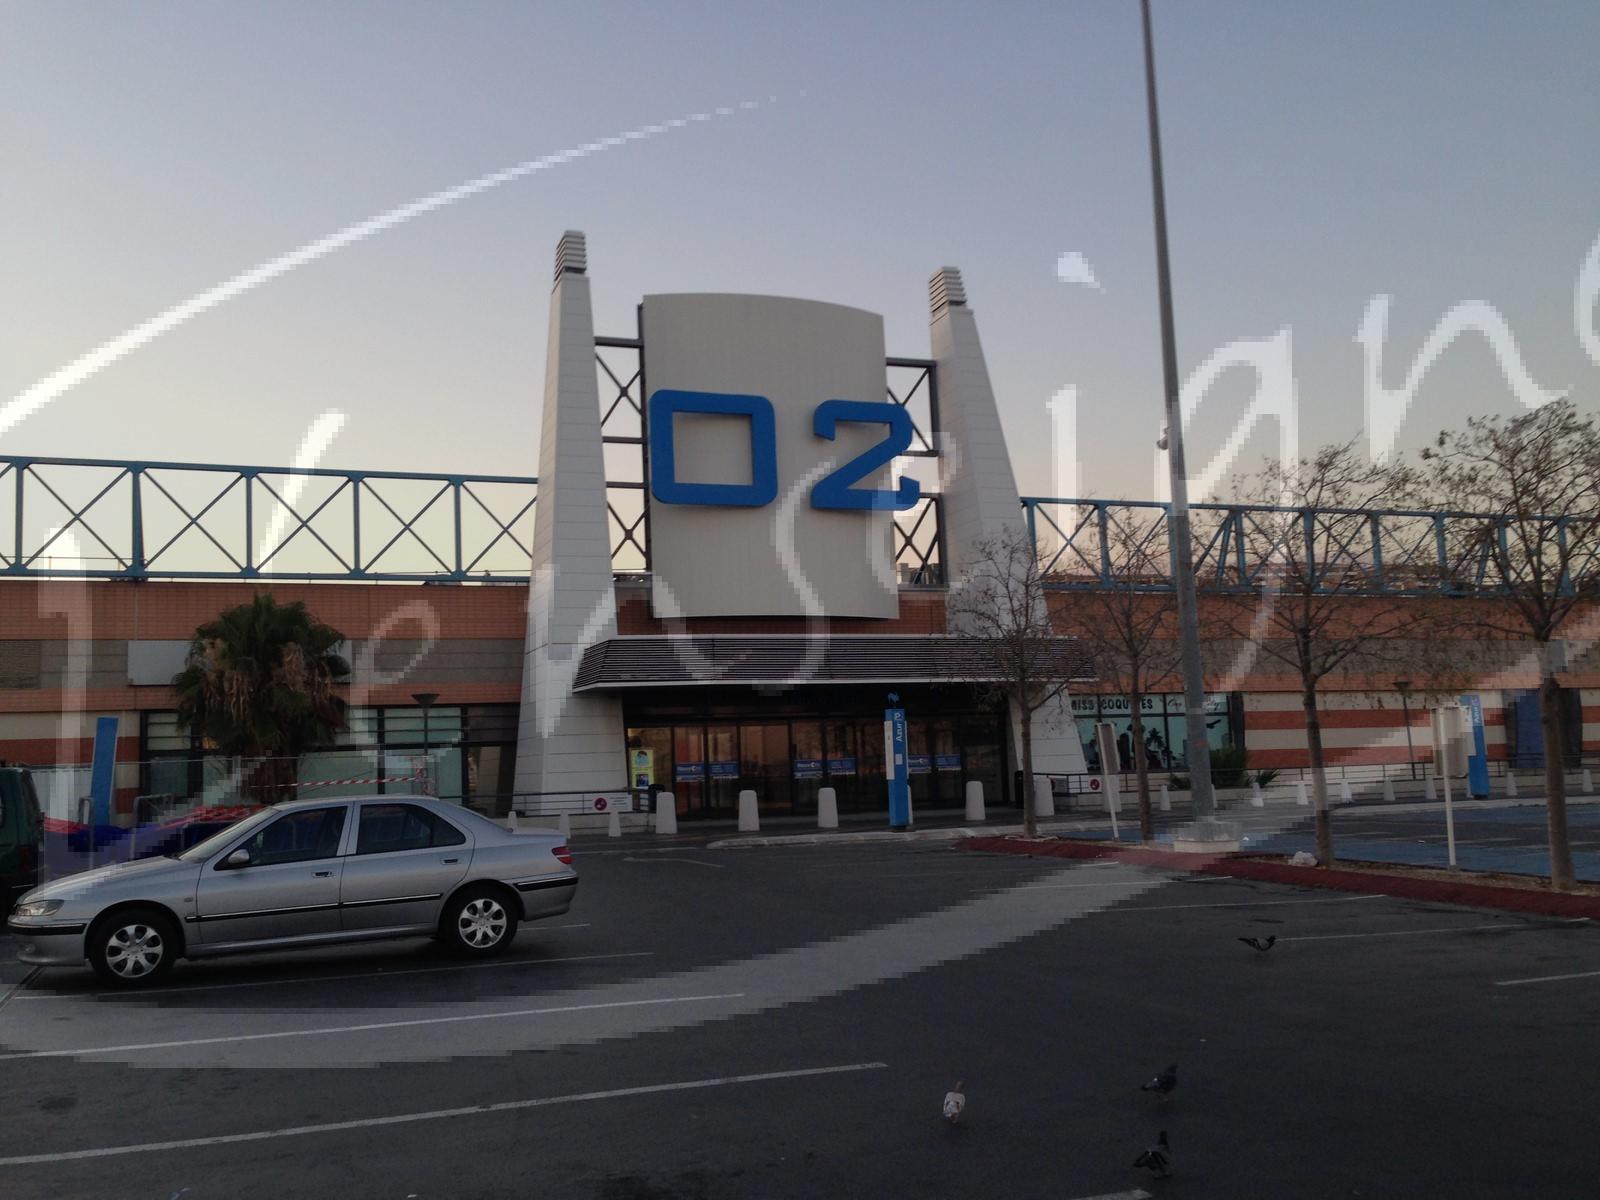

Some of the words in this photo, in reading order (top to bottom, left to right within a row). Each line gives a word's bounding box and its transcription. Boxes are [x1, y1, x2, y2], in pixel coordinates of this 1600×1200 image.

[650, 389, 920, 511] O2
[1101, 698, 1153, 710] COQUES
[895, 721, 904, 743] Azur
